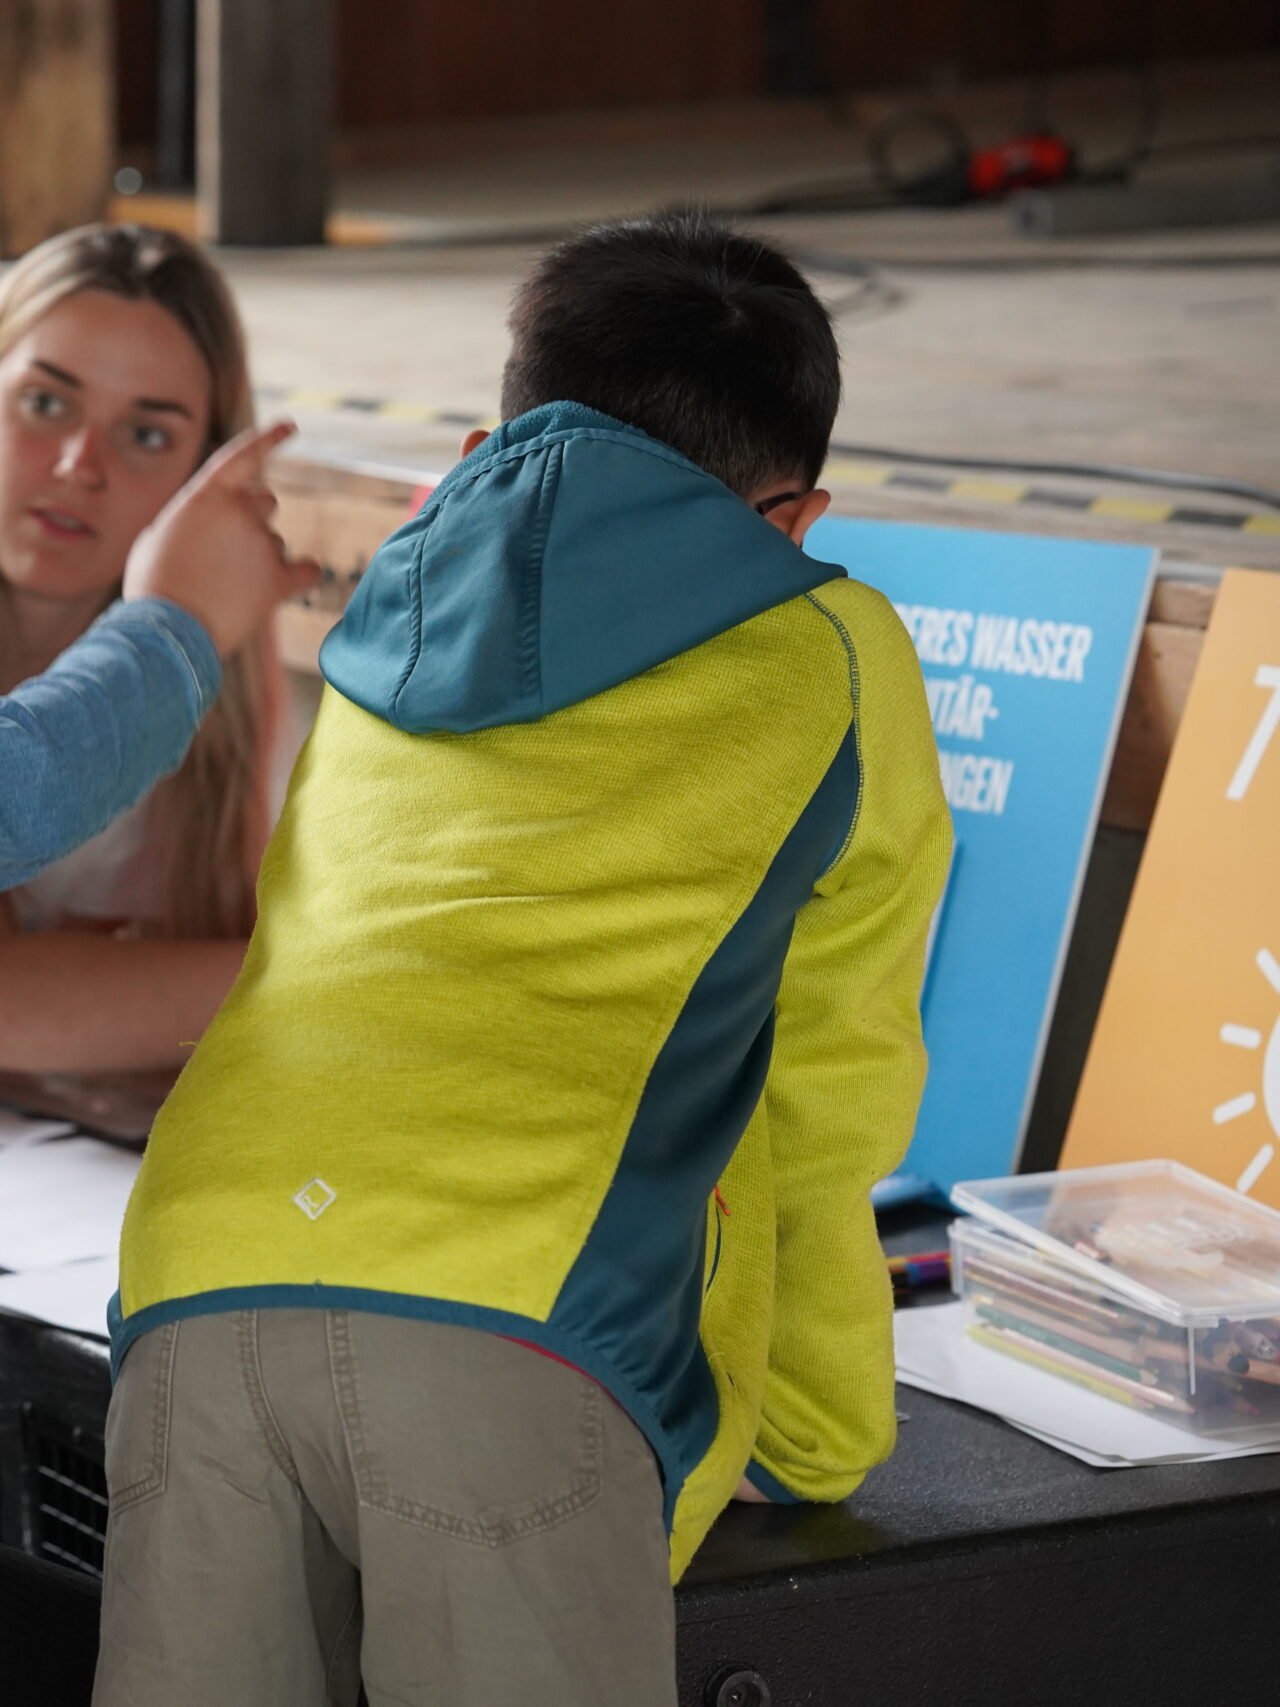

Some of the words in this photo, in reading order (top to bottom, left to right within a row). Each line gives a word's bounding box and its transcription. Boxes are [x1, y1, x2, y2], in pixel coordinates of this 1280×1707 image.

[971, 613, 1093, 683] WASSER
[925, 673, 1000, 742] ITÄR-
[938, 751, 1015, 816] NGEN
